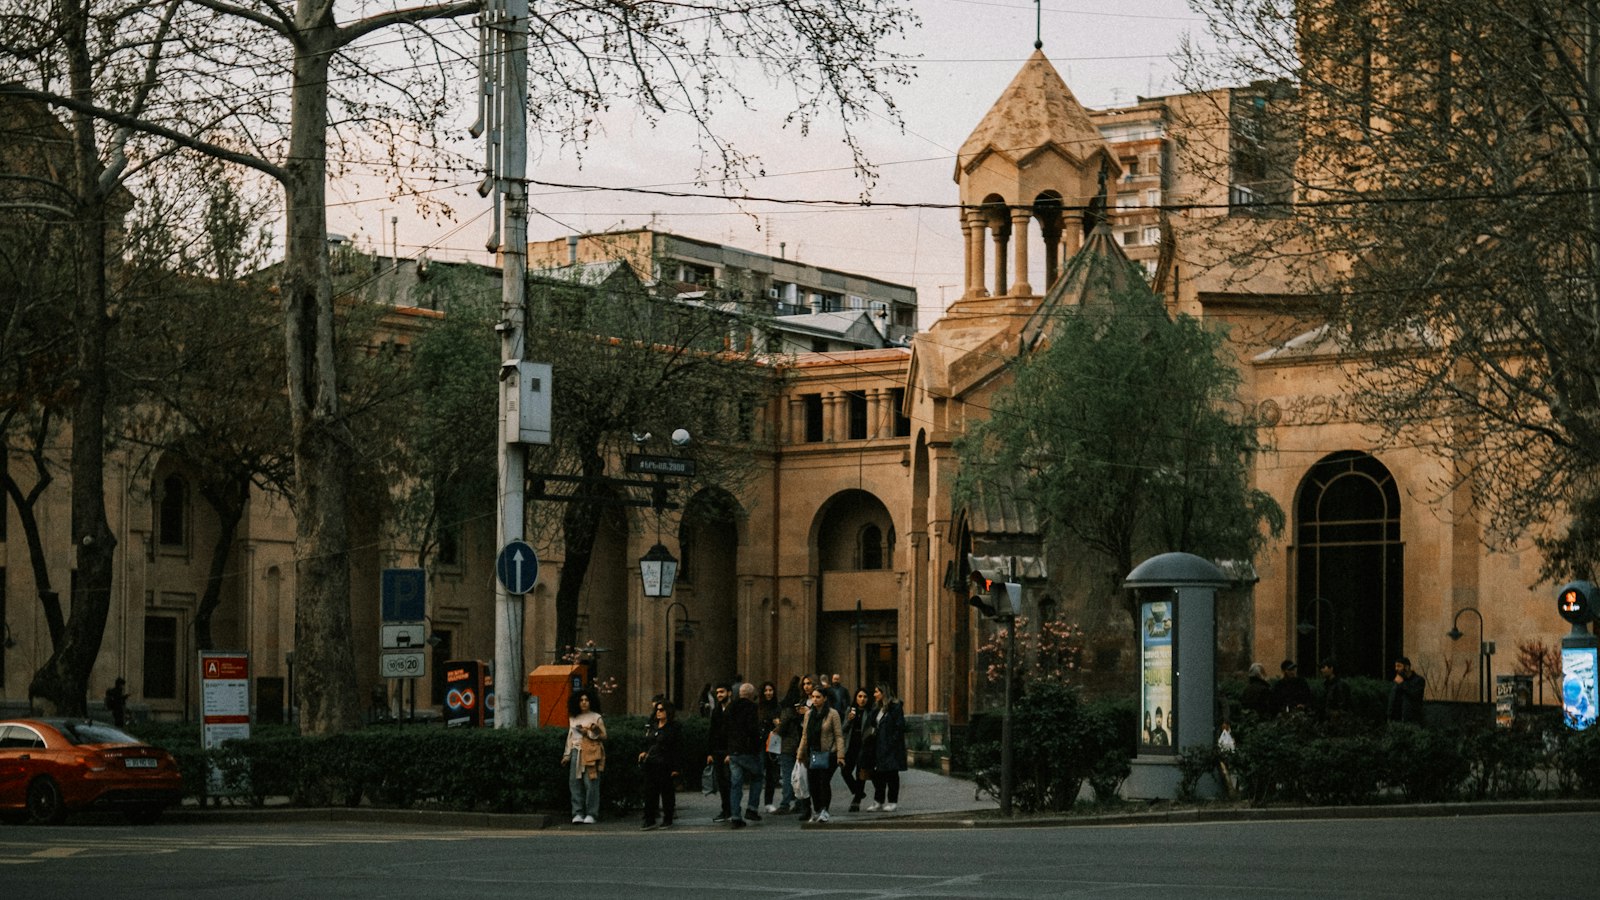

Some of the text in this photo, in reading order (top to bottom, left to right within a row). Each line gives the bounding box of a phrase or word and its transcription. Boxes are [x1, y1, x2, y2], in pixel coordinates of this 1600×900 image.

[208, 662, 217, 672] A
[397, 661, 405, 669] 15
[407, 660, 417, 669] 20
